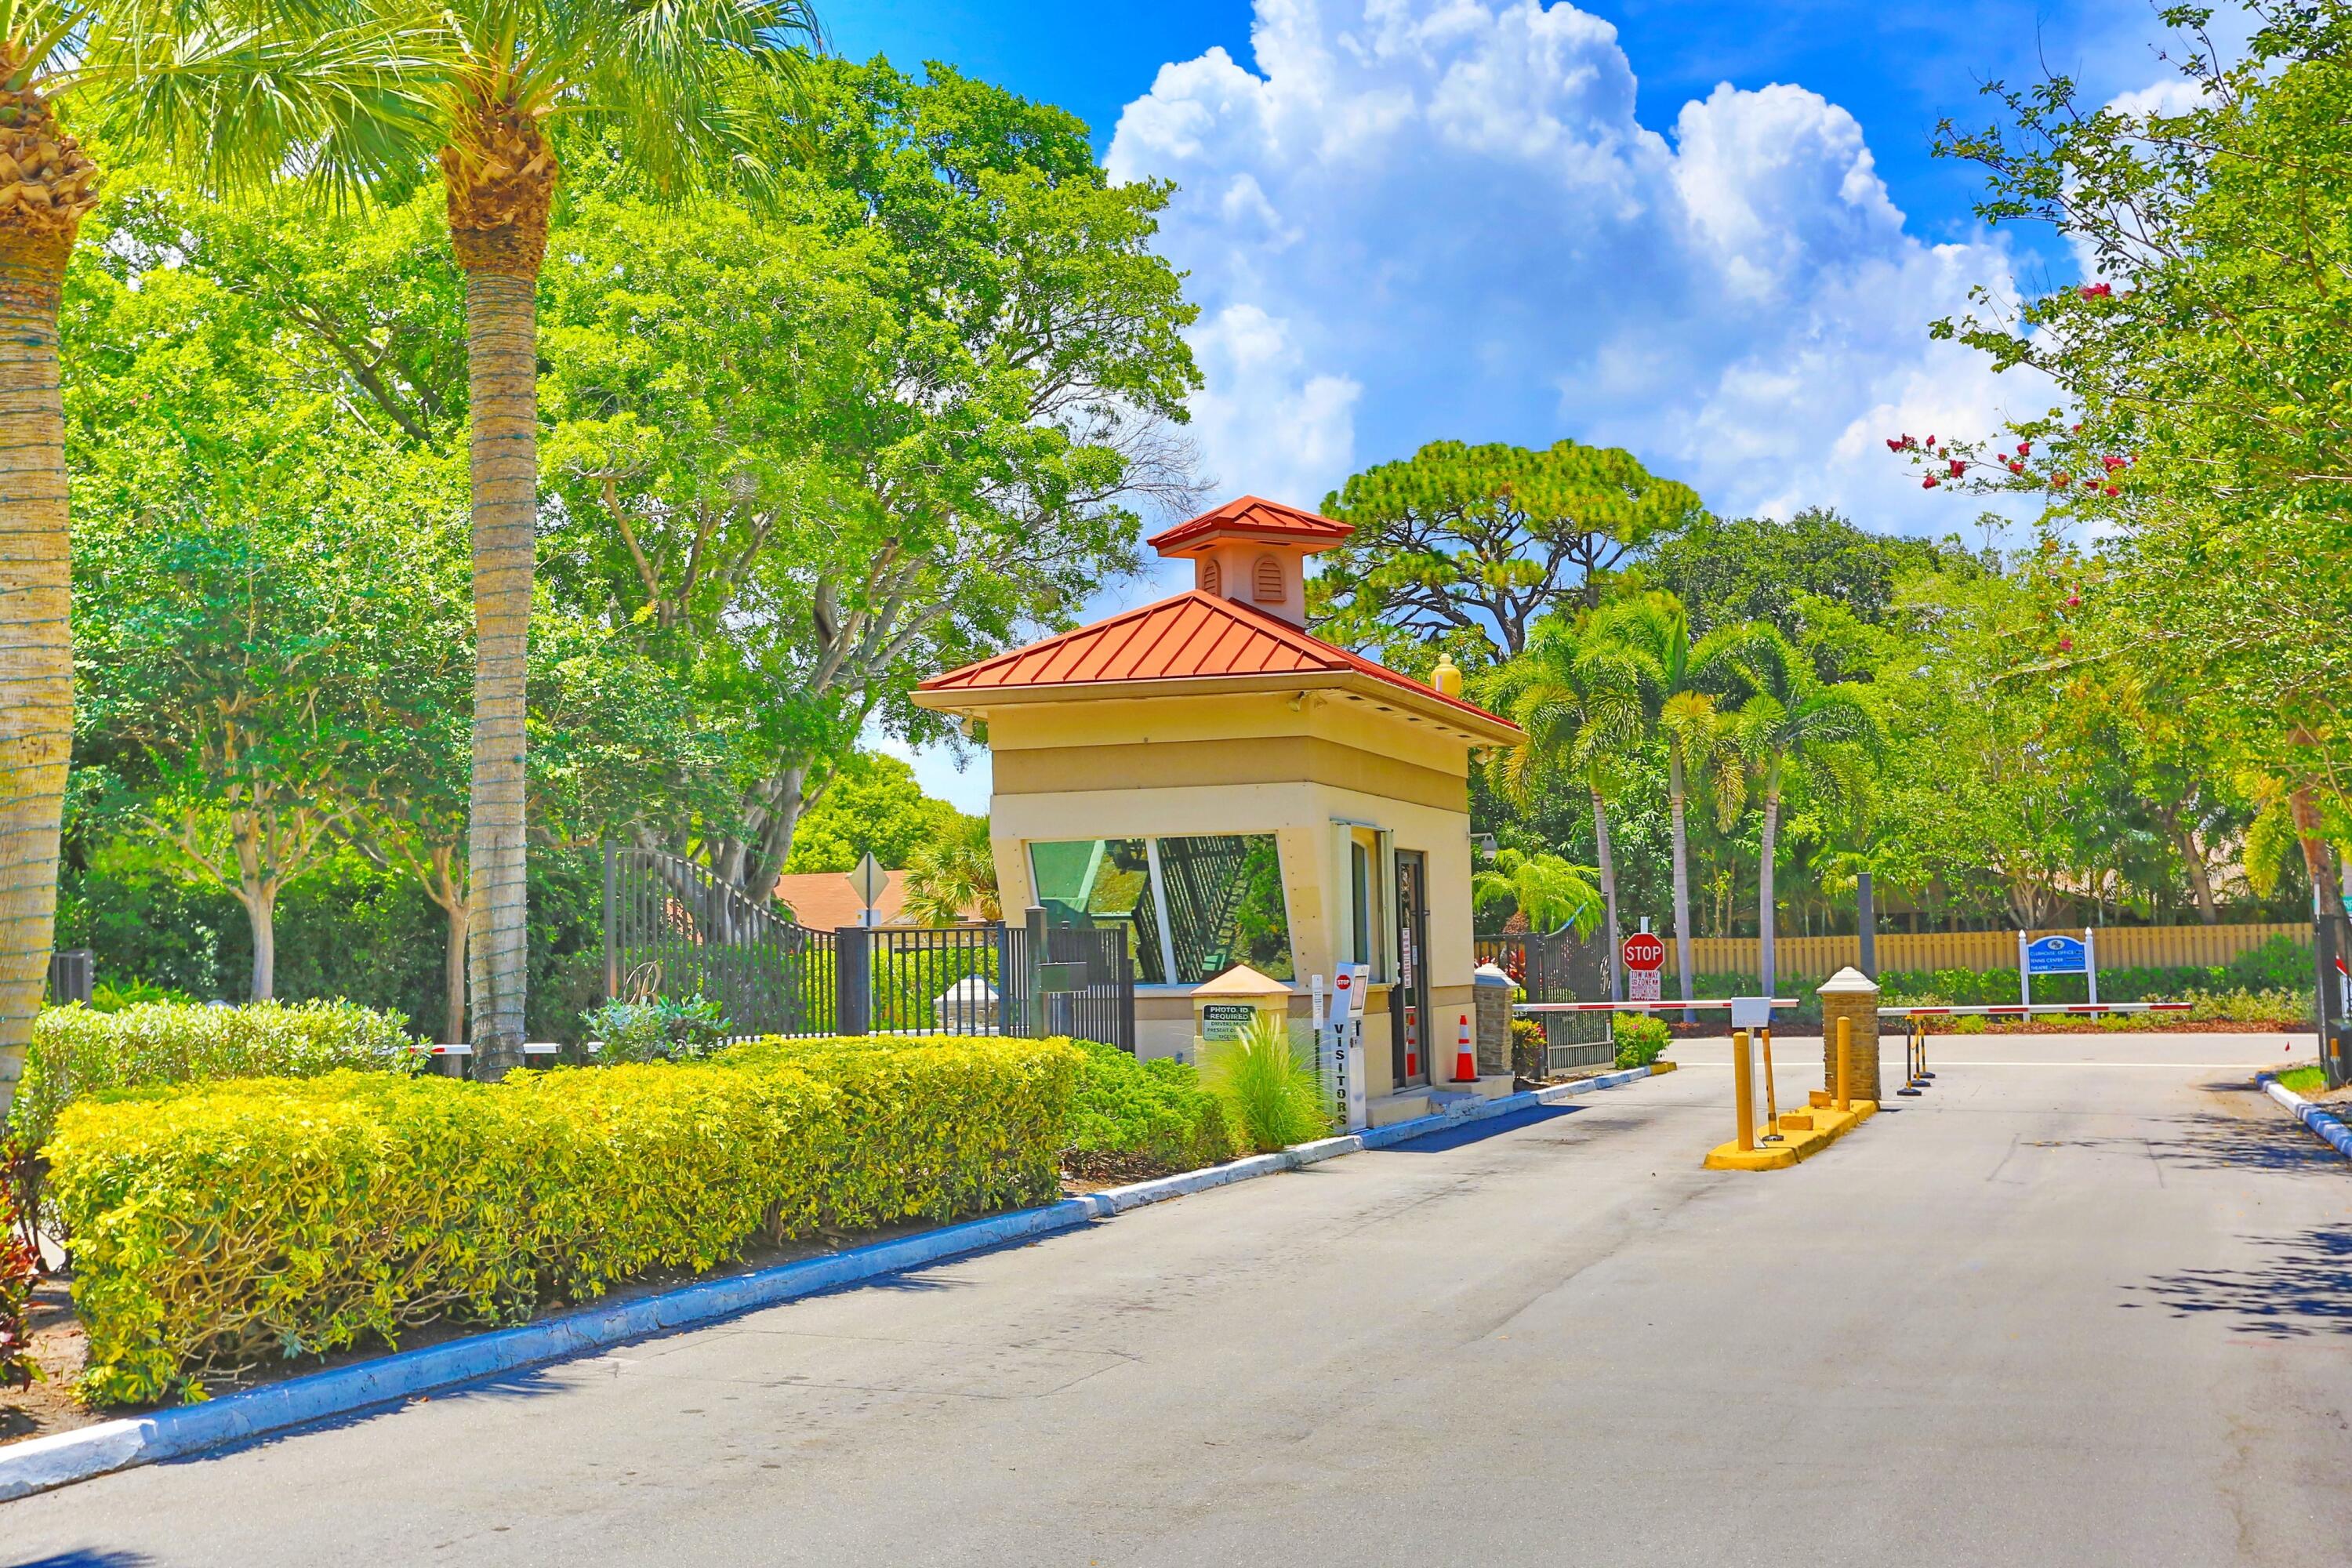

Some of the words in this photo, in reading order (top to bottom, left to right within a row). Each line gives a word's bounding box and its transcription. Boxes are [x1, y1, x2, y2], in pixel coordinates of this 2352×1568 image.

[1626, 946, 1661, 960] STOP
[1638, 978, 1652, 986] ZONE
[1334, 1023, 1347, 1125] VISITORS
